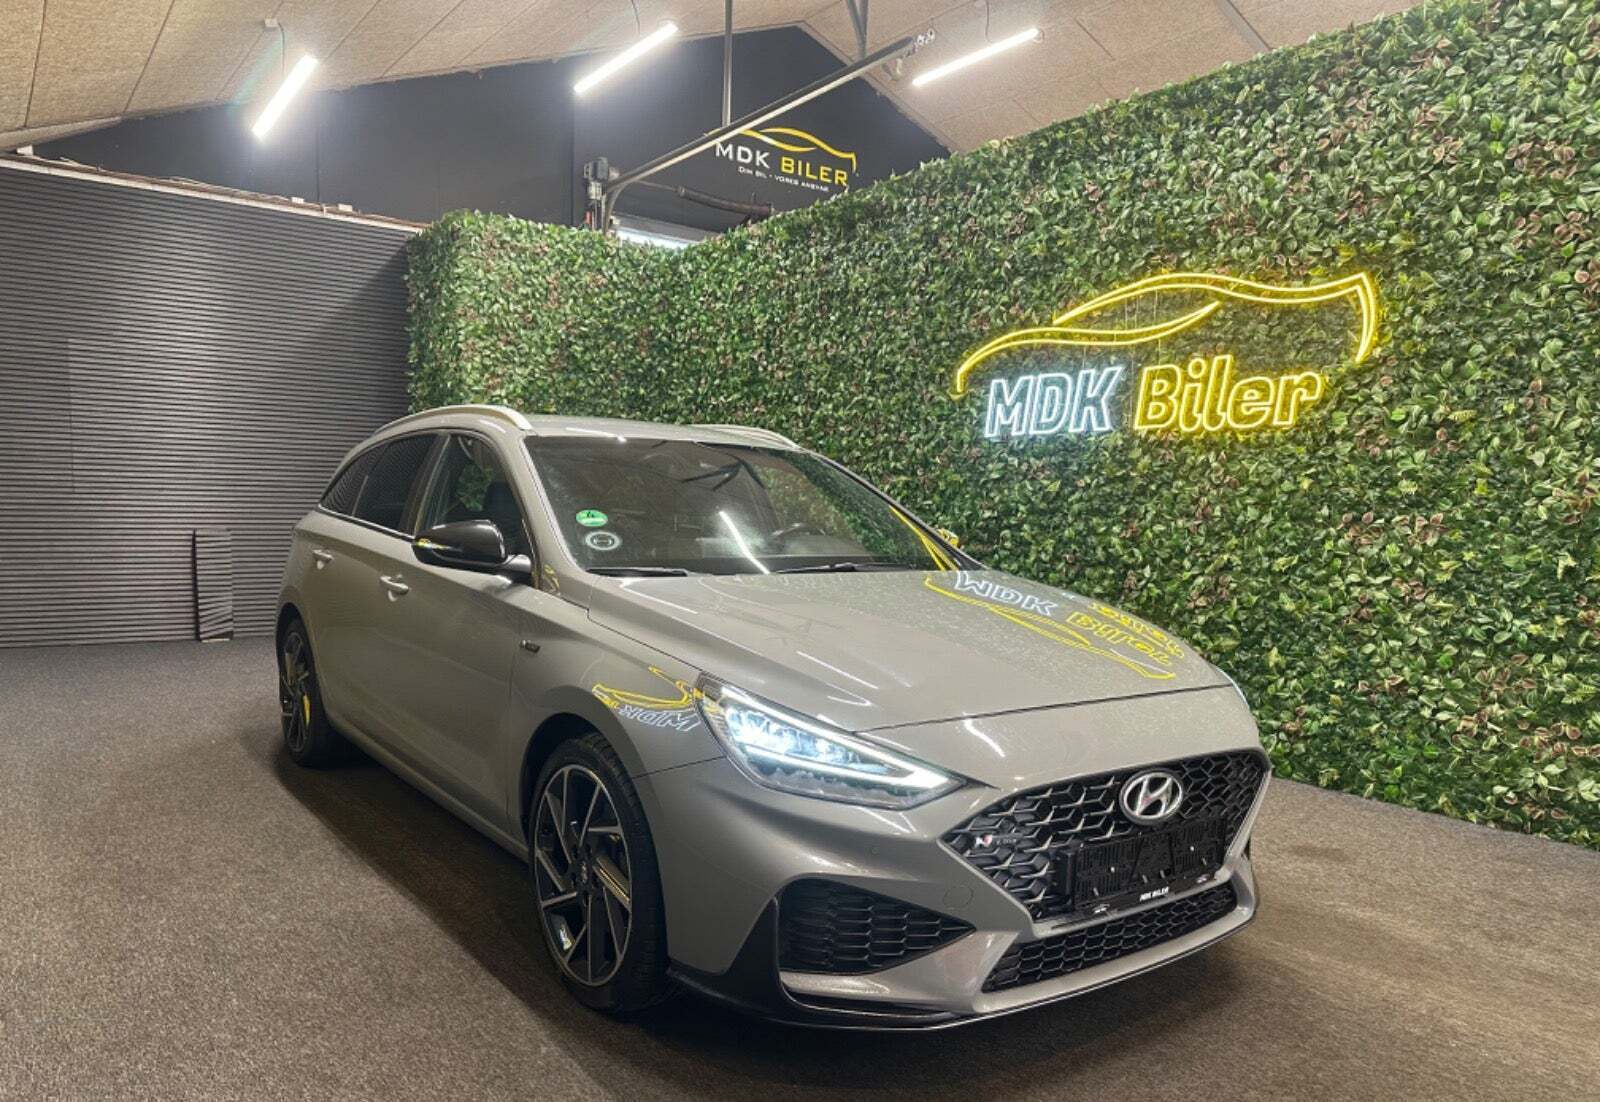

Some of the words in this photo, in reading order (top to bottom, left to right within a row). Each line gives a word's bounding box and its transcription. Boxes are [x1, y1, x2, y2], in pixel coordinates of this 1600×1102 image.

[715, 142, 770, 169] MDK
[780, 156, 848, 186] BILER
[984, 364, 1125, 438] MDK
[1134, 353, 1322, 433] Biler
